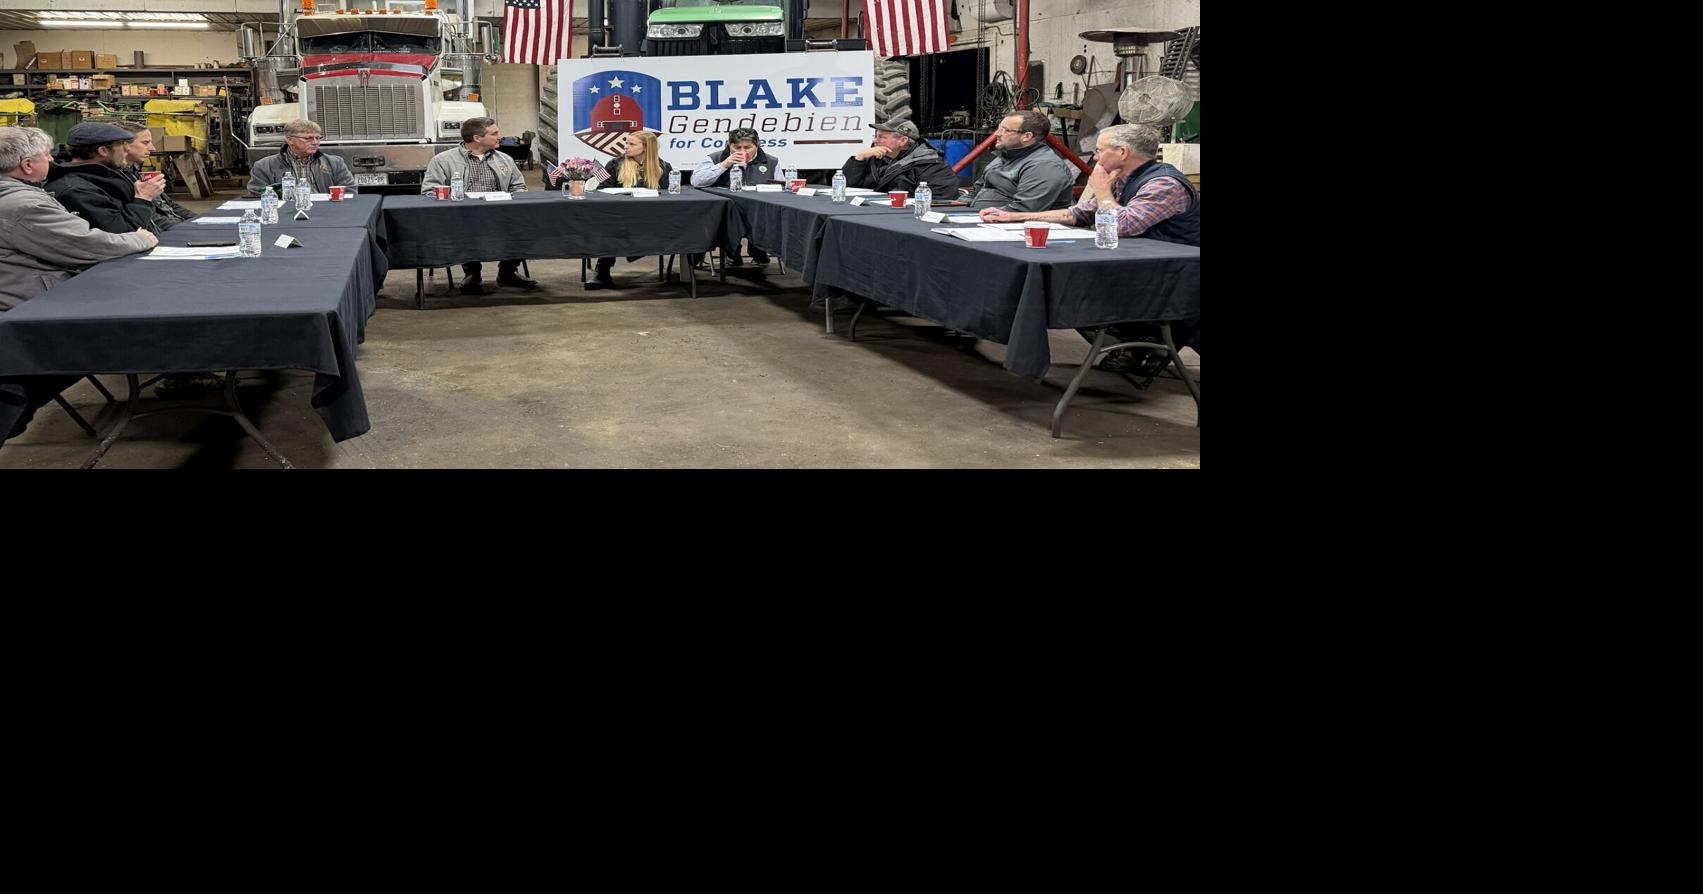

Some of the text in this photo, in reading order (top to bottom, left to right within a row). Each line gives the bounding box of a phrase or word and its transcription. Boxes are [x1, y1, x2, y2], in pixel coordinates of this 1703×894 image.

[667, 76, 863, 111] BLAKE
[669, 112, 861, 133] Gendebien
[669, 137, 788, 149] for Coess
